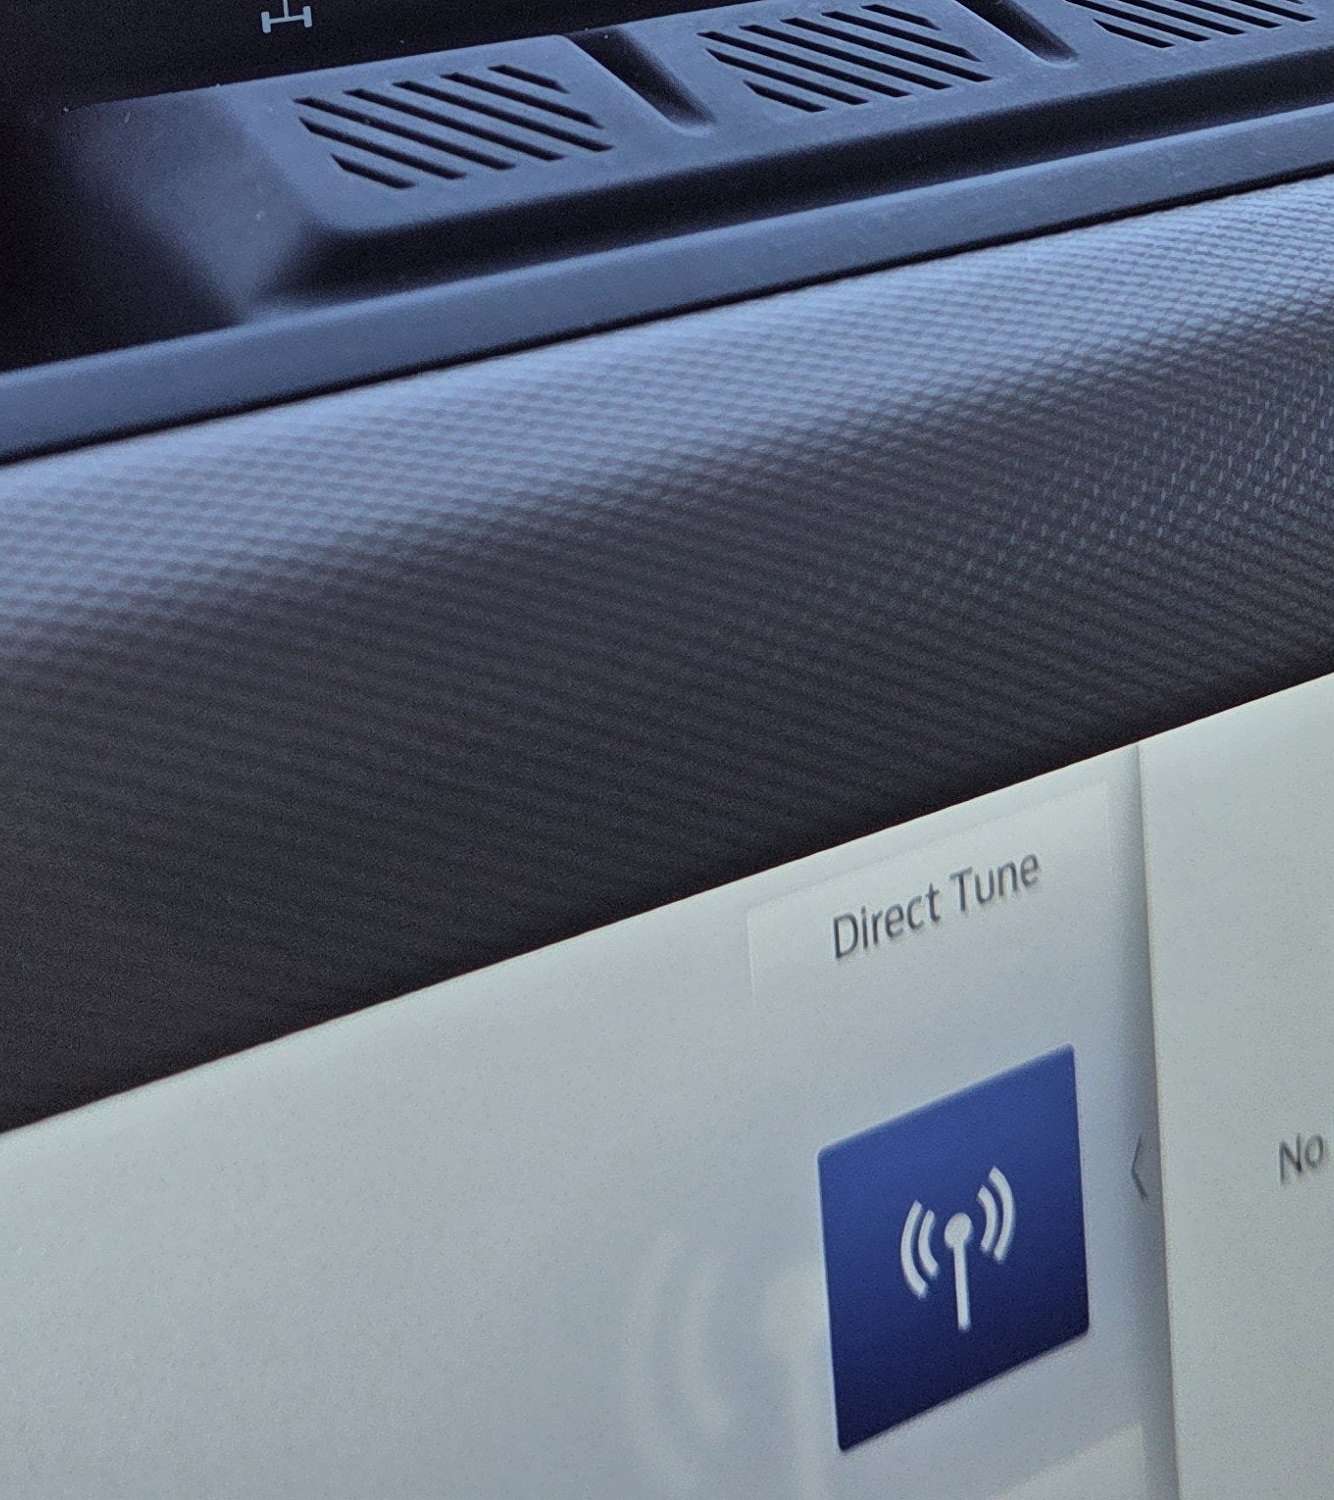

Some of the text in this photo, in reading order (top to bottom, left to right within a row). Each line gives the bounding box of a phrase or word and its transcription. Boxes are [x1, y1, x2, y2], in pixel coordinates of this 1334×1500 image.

[833, 854, 1039, 960] Direct Tune
[1278, 1132, 1324, 1185] No
